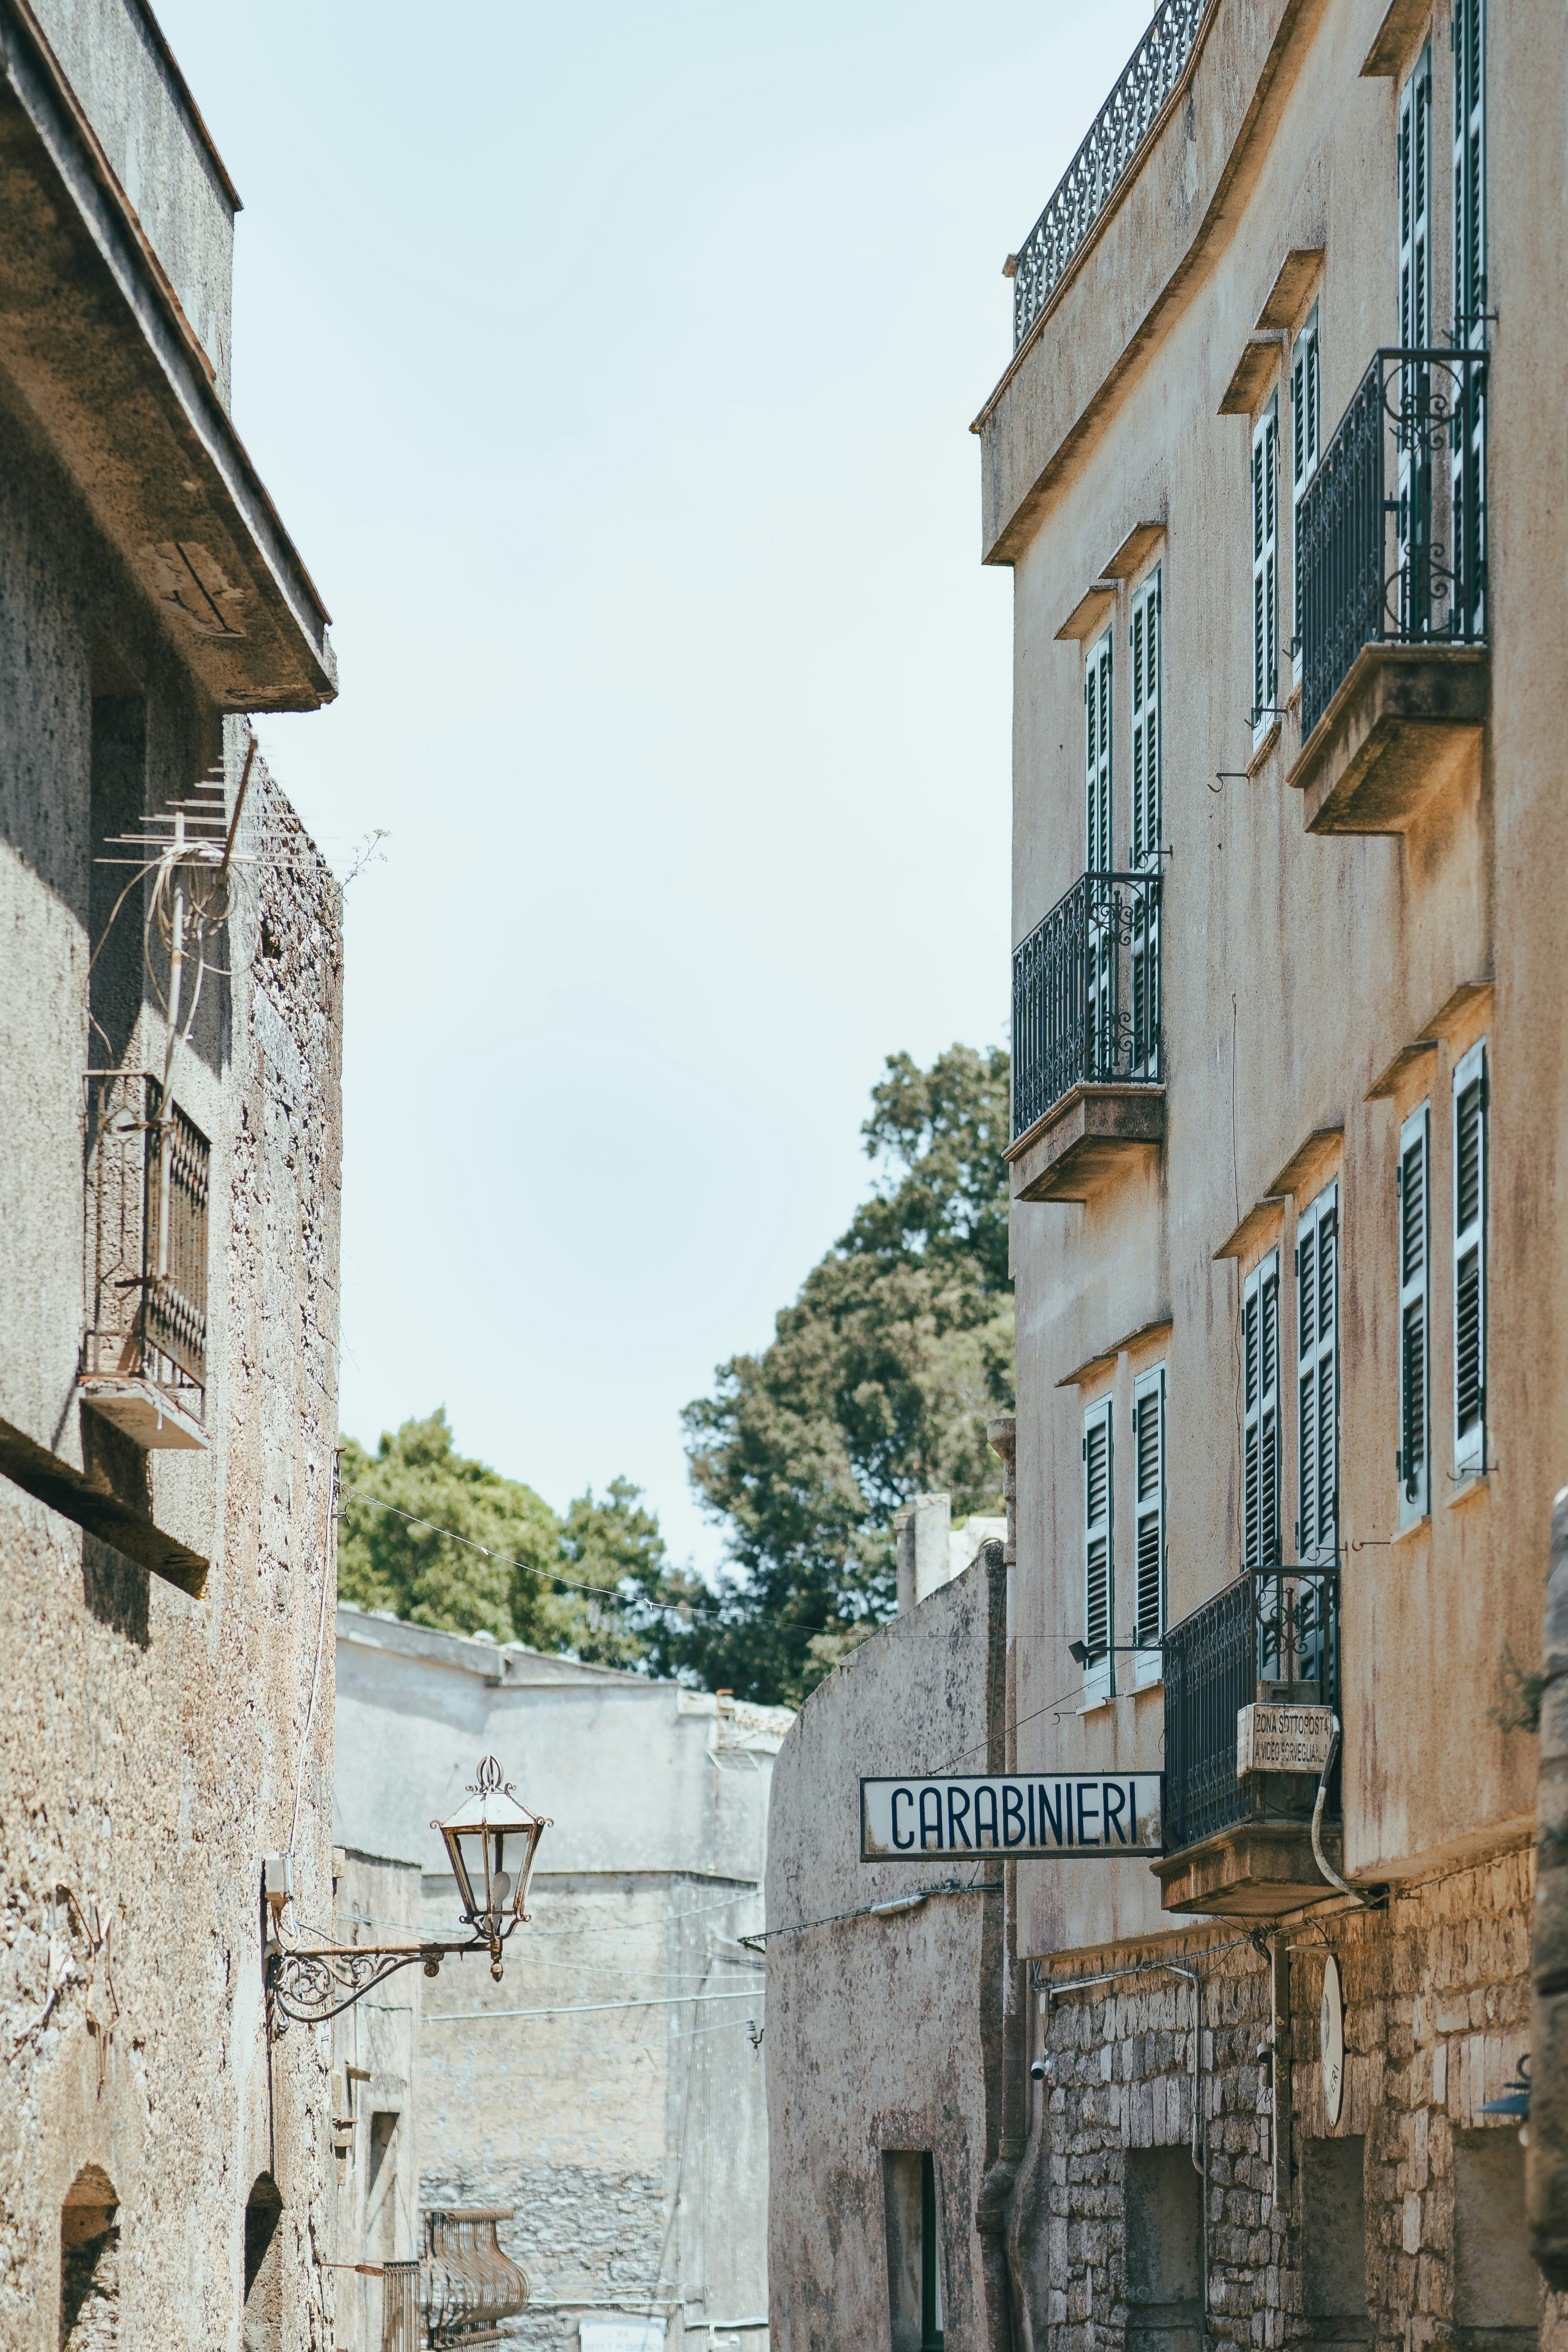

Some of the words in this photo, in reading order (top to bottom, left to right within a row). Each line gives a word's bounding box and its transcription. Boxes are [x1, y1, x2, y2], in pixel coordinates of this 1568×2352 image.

[1256, 1713, 1276, 1733] ZONA
[1279, 1714, 1329, 1736] SOTTOPOSTA
[1255, 1741, 1260, 1760] A
[1262, 1741, 1279, 1761] VIDEO
[891, 1781, 1137, 1850] CARABINIERI
